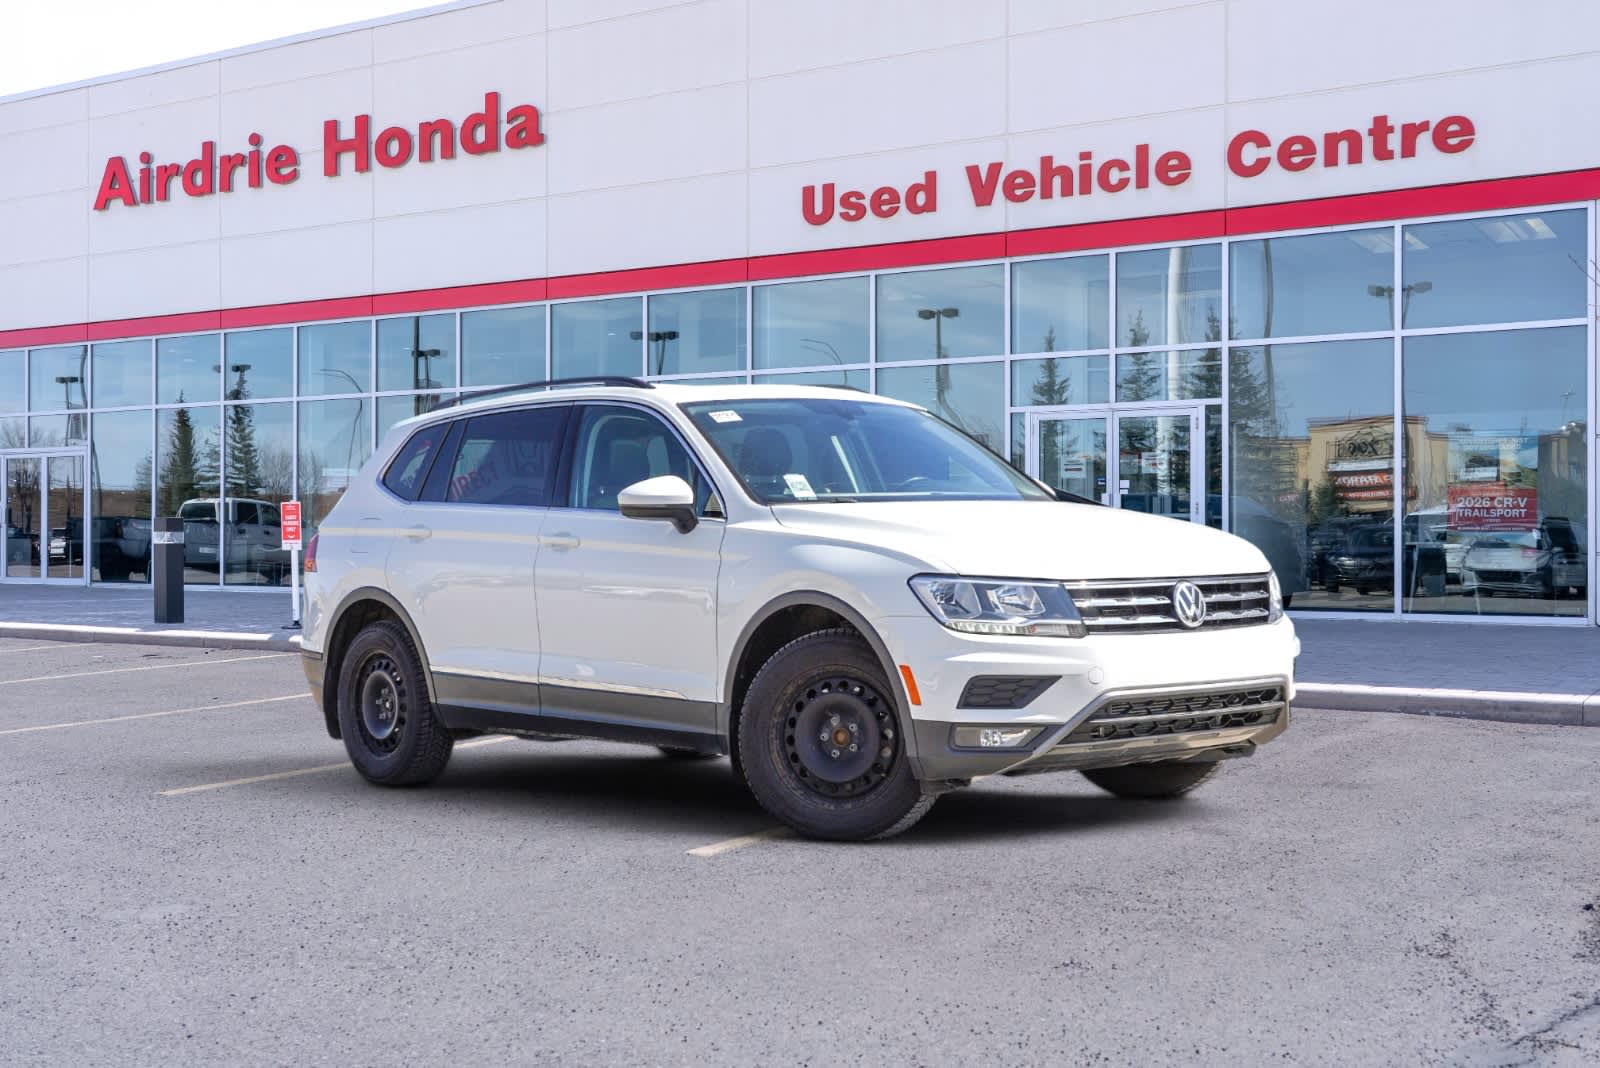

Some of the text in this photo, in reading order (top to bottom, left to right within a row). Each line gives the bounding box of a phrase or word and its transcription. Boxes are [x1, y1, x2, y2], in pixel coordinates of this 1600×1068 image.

[94, 91, 546, 212] Airdrie Honda
[801, 114, 1476, 227] Used Vehicle Centre
[1457, 496, 1528, 508] 2026 CR-V
[1458, 508, 1527, 517] TRAILSPORT
